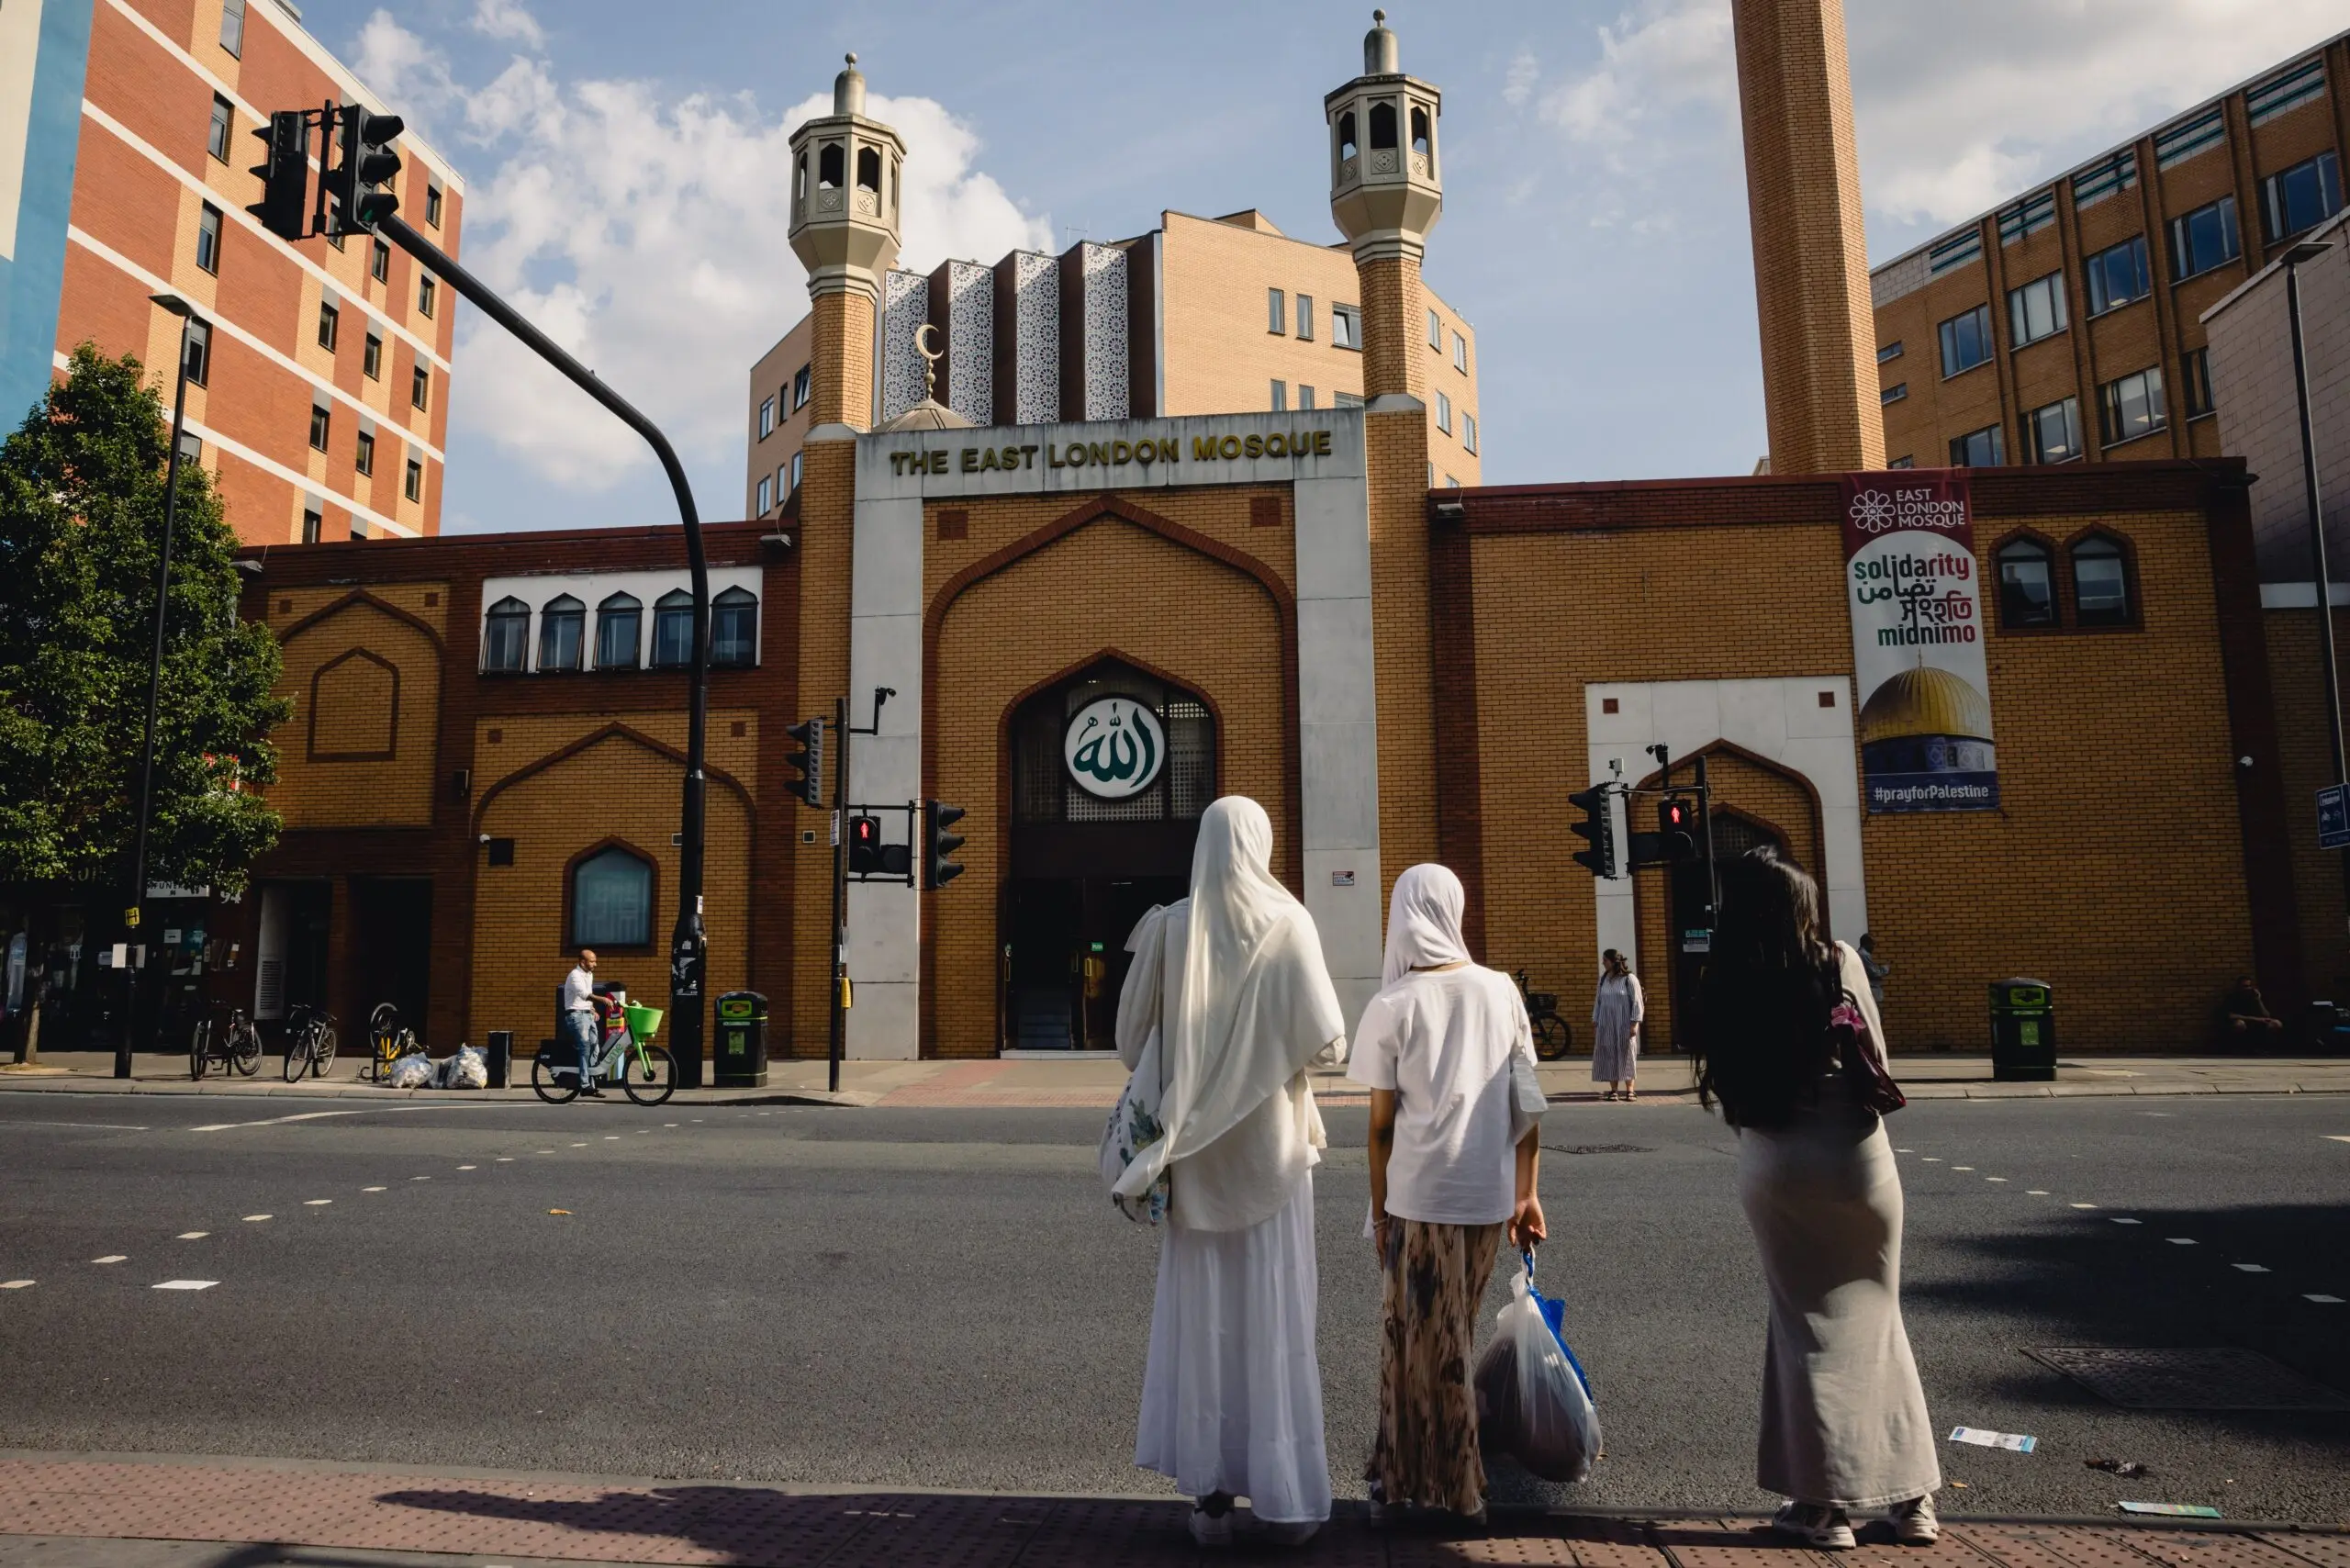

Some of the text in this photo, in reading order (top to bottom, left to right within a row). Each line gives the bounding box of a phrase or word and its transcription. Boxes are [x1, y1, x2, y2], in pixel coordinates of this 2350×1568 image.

[890, 431, 1332, 476] THE EAST LONDON MOSQUE
[1896, 488, 1931, 501] EAST
[1897, 501, 1964, 514] LONDON
[1898, 514, 1965, 528] MOSQUE
[1854, 554, 1970, 580] solidarity
[1857, 578, 1937, 605] تضامن
[1877, 622, 1975, 646] midnimo
[1874, 784, 1989, 804] #prayforPalestine
